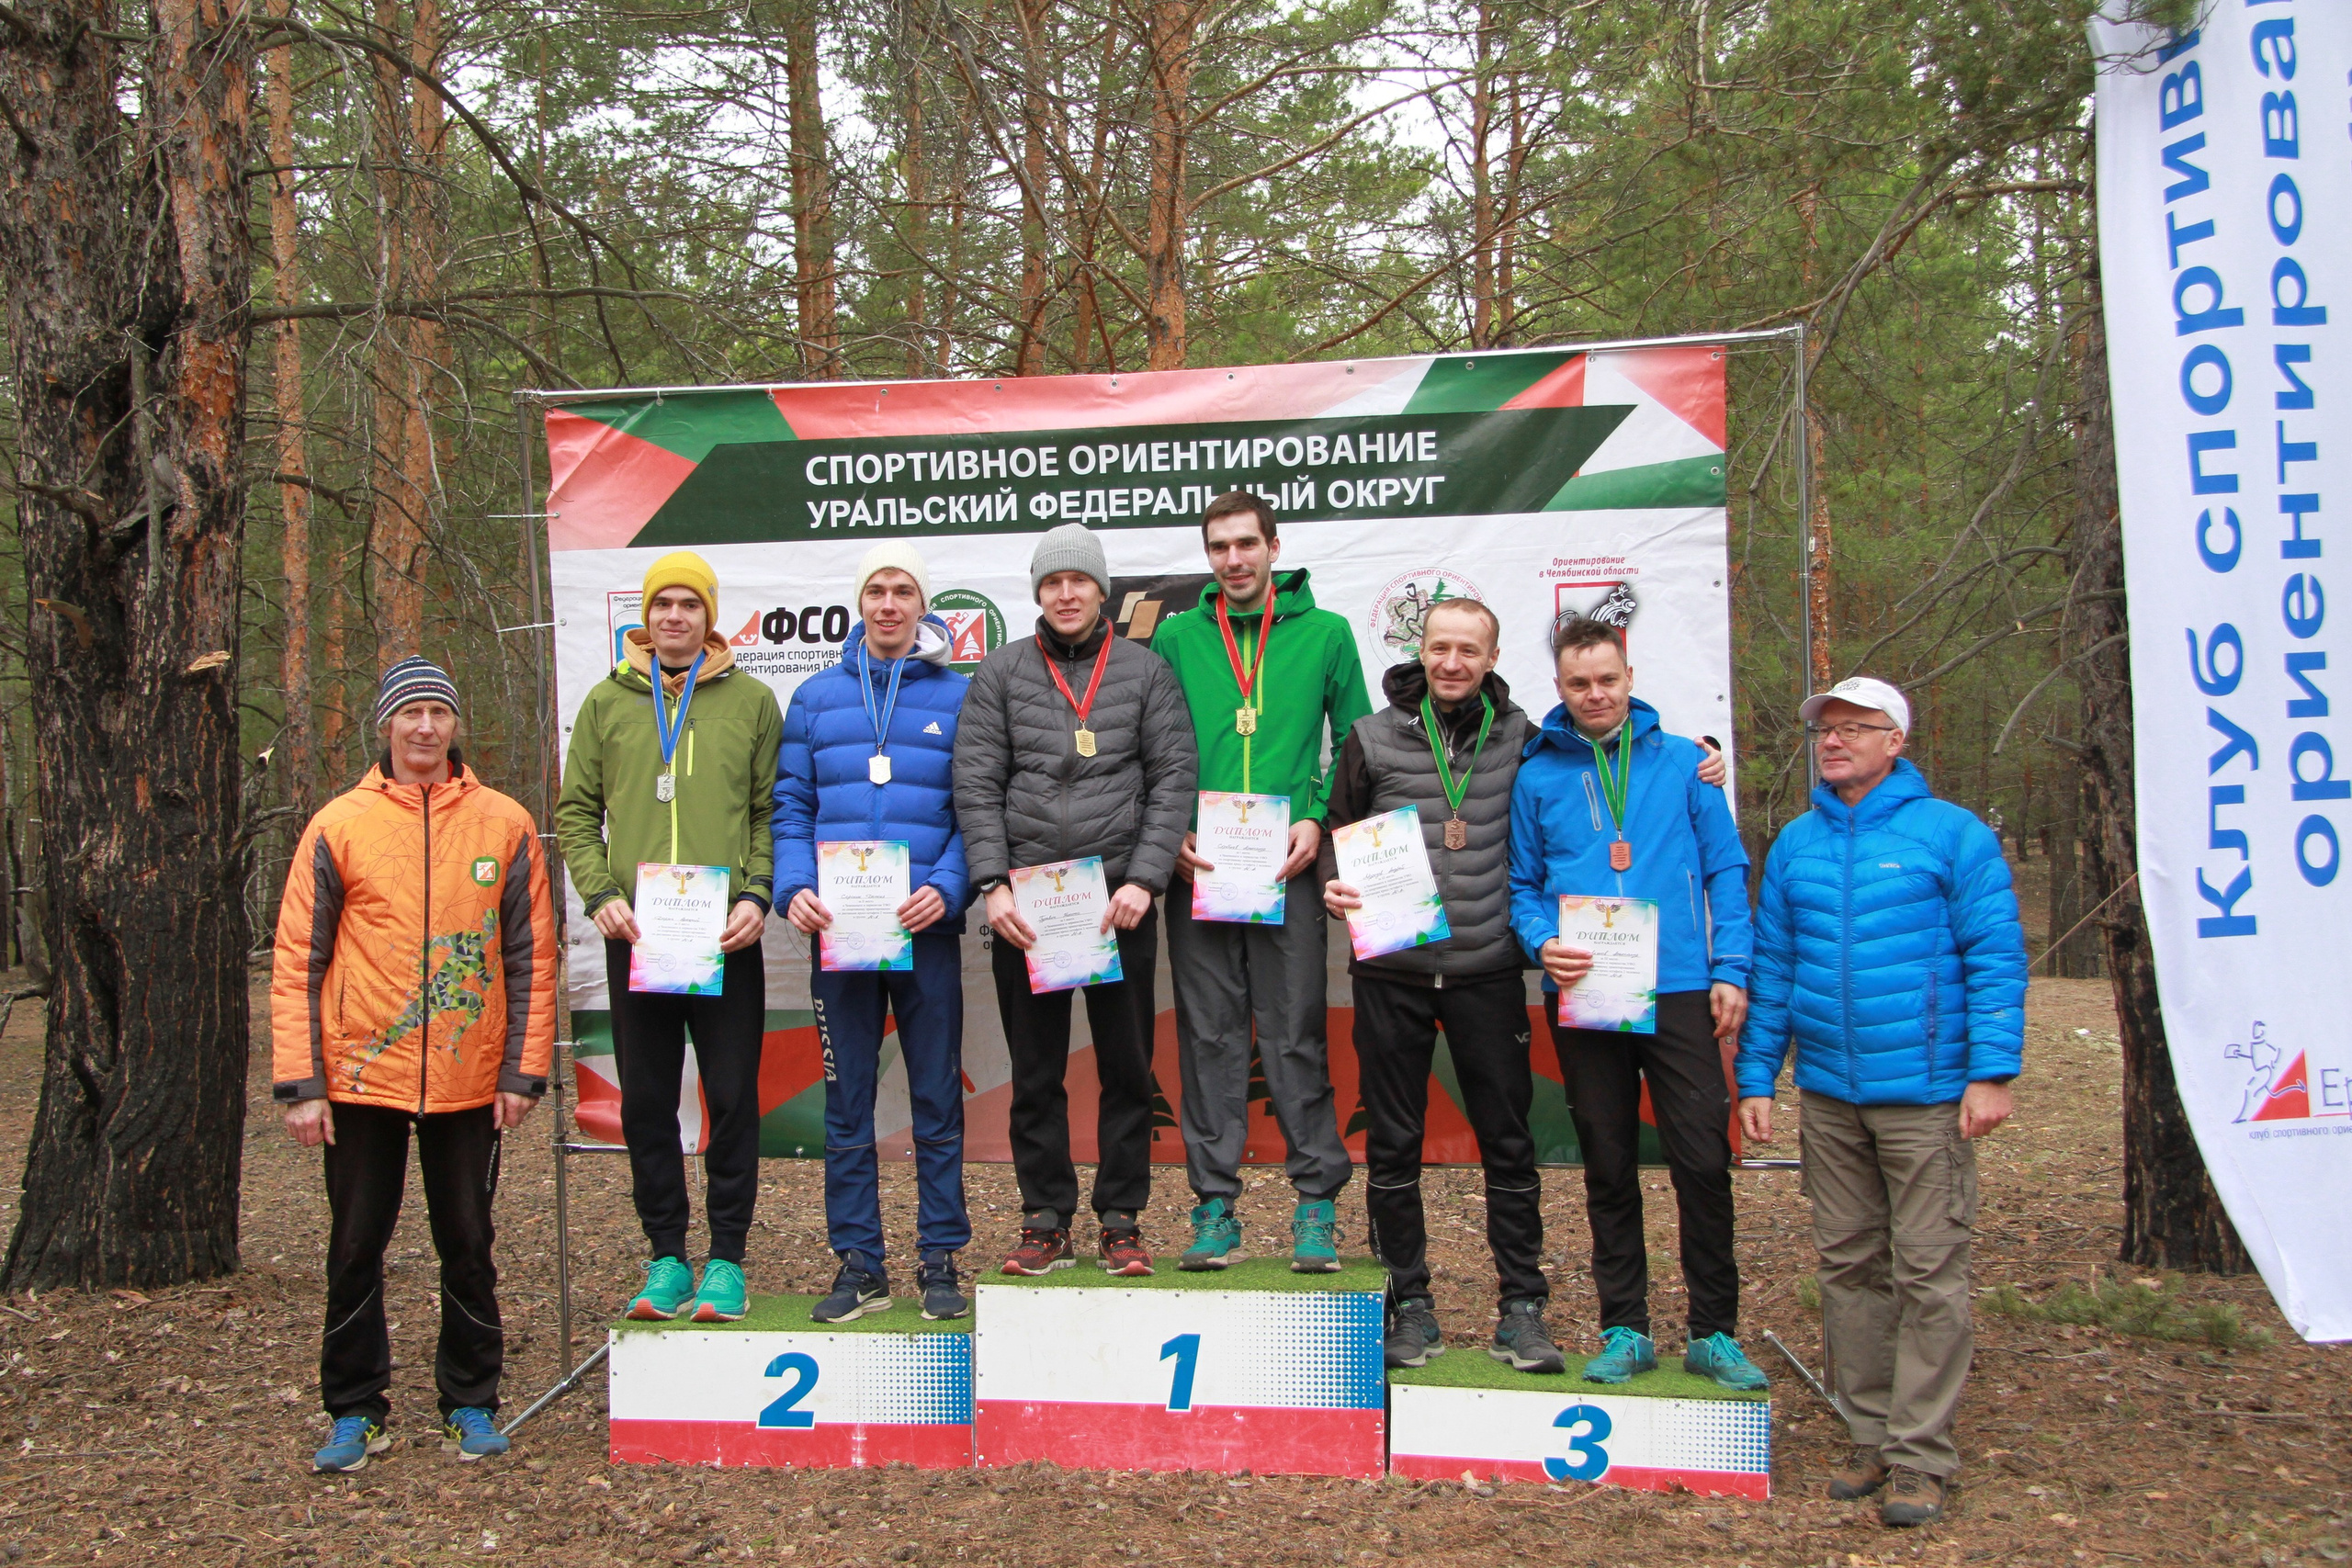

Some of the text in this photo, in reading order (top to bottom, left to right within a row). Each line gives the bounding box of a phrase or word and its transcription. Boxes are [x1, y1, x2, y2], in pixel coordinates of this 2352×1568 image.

[806, 431, 1437, 485] СПОРТИВНОЕ ОРИЕНТИРОВАНИЕ
[2245, 0, 2351, 887] ориентирова
[807, 474, 1445, 529] УРАЛЬСКИЙ ФЕДЕРАЛЬЫЙ ОКРУГ
[1538, 566, 1639, 579] в Челябинской области
[1553, 556, 1625, 568] Ориентирование
[1370, 587, 1391, 628] ФЕДЕРАЦИЯ
[1390, 569, 1442, 590] СПОРТИВНОГО
[762, 604, 850, 645] ФСО
[940, 592, 1003, 649] СПОРТИВНОГО ОРИЕНТИРО
[735, 649, 843, 664] дерация спортивн
[2185, 623, 2258, 939] Клуб
[1213, 826, 1273, 838] ДИПЛОМ
[1351, 844, 1409, 868] ДИПЛОМ
[833, 874, 893, 885] ДИПЛОМ
[651, 897, 712, 908] ДИПЛОМ
[1031, 891, 1092, 908] ДИПЛОМ
[1575, 931, 1640, 942] ДИПЛОМ
[2248, 1128, 2270, 1141] клуб
[2273, 1126, 2329, 1138] спортивного
[1159, 1333, 1201, 1410] 1
[758, 1351, 820, 1427] 2
[1544, 1404, 1612, 1482] 3
